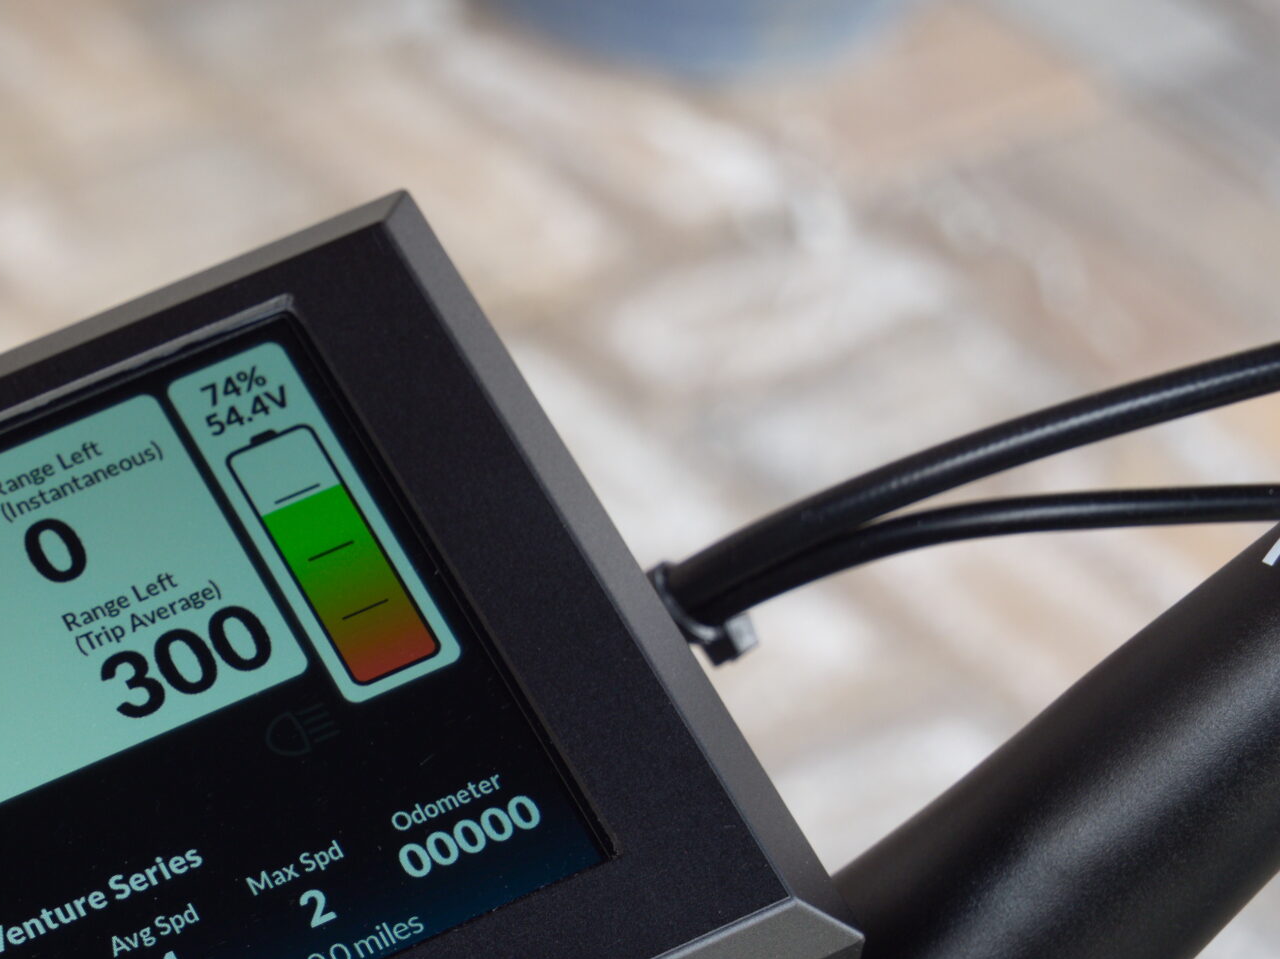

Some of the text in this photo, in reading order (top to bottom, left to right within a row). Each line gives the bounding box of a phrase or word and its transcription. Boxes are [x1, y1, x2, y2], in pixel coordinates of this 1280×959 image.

[200, 366, 267, 407] 74%
[205, 385, 289, 437] 54.4V
[0, 441, 164, 523] (Instantaneous)
[60, 441, 103, 471] Left
[23, 517, 87, 583] 0
[61, 572, 178, 632] Range Left
[74, 579, 222, 657] (Trip Average)
[100, 605, 272, 719] 300
[391, 771, 501, 832] Odometer
[398, 794, 542, 878] 00000
[108, 847, 203, 900] Series
[245, 839, 345, 897] Max Spd
[110, 903, 201, 959] Avg Spd
[299, 889, 337, 929] 2
[352, 913, 425, 959] miles
